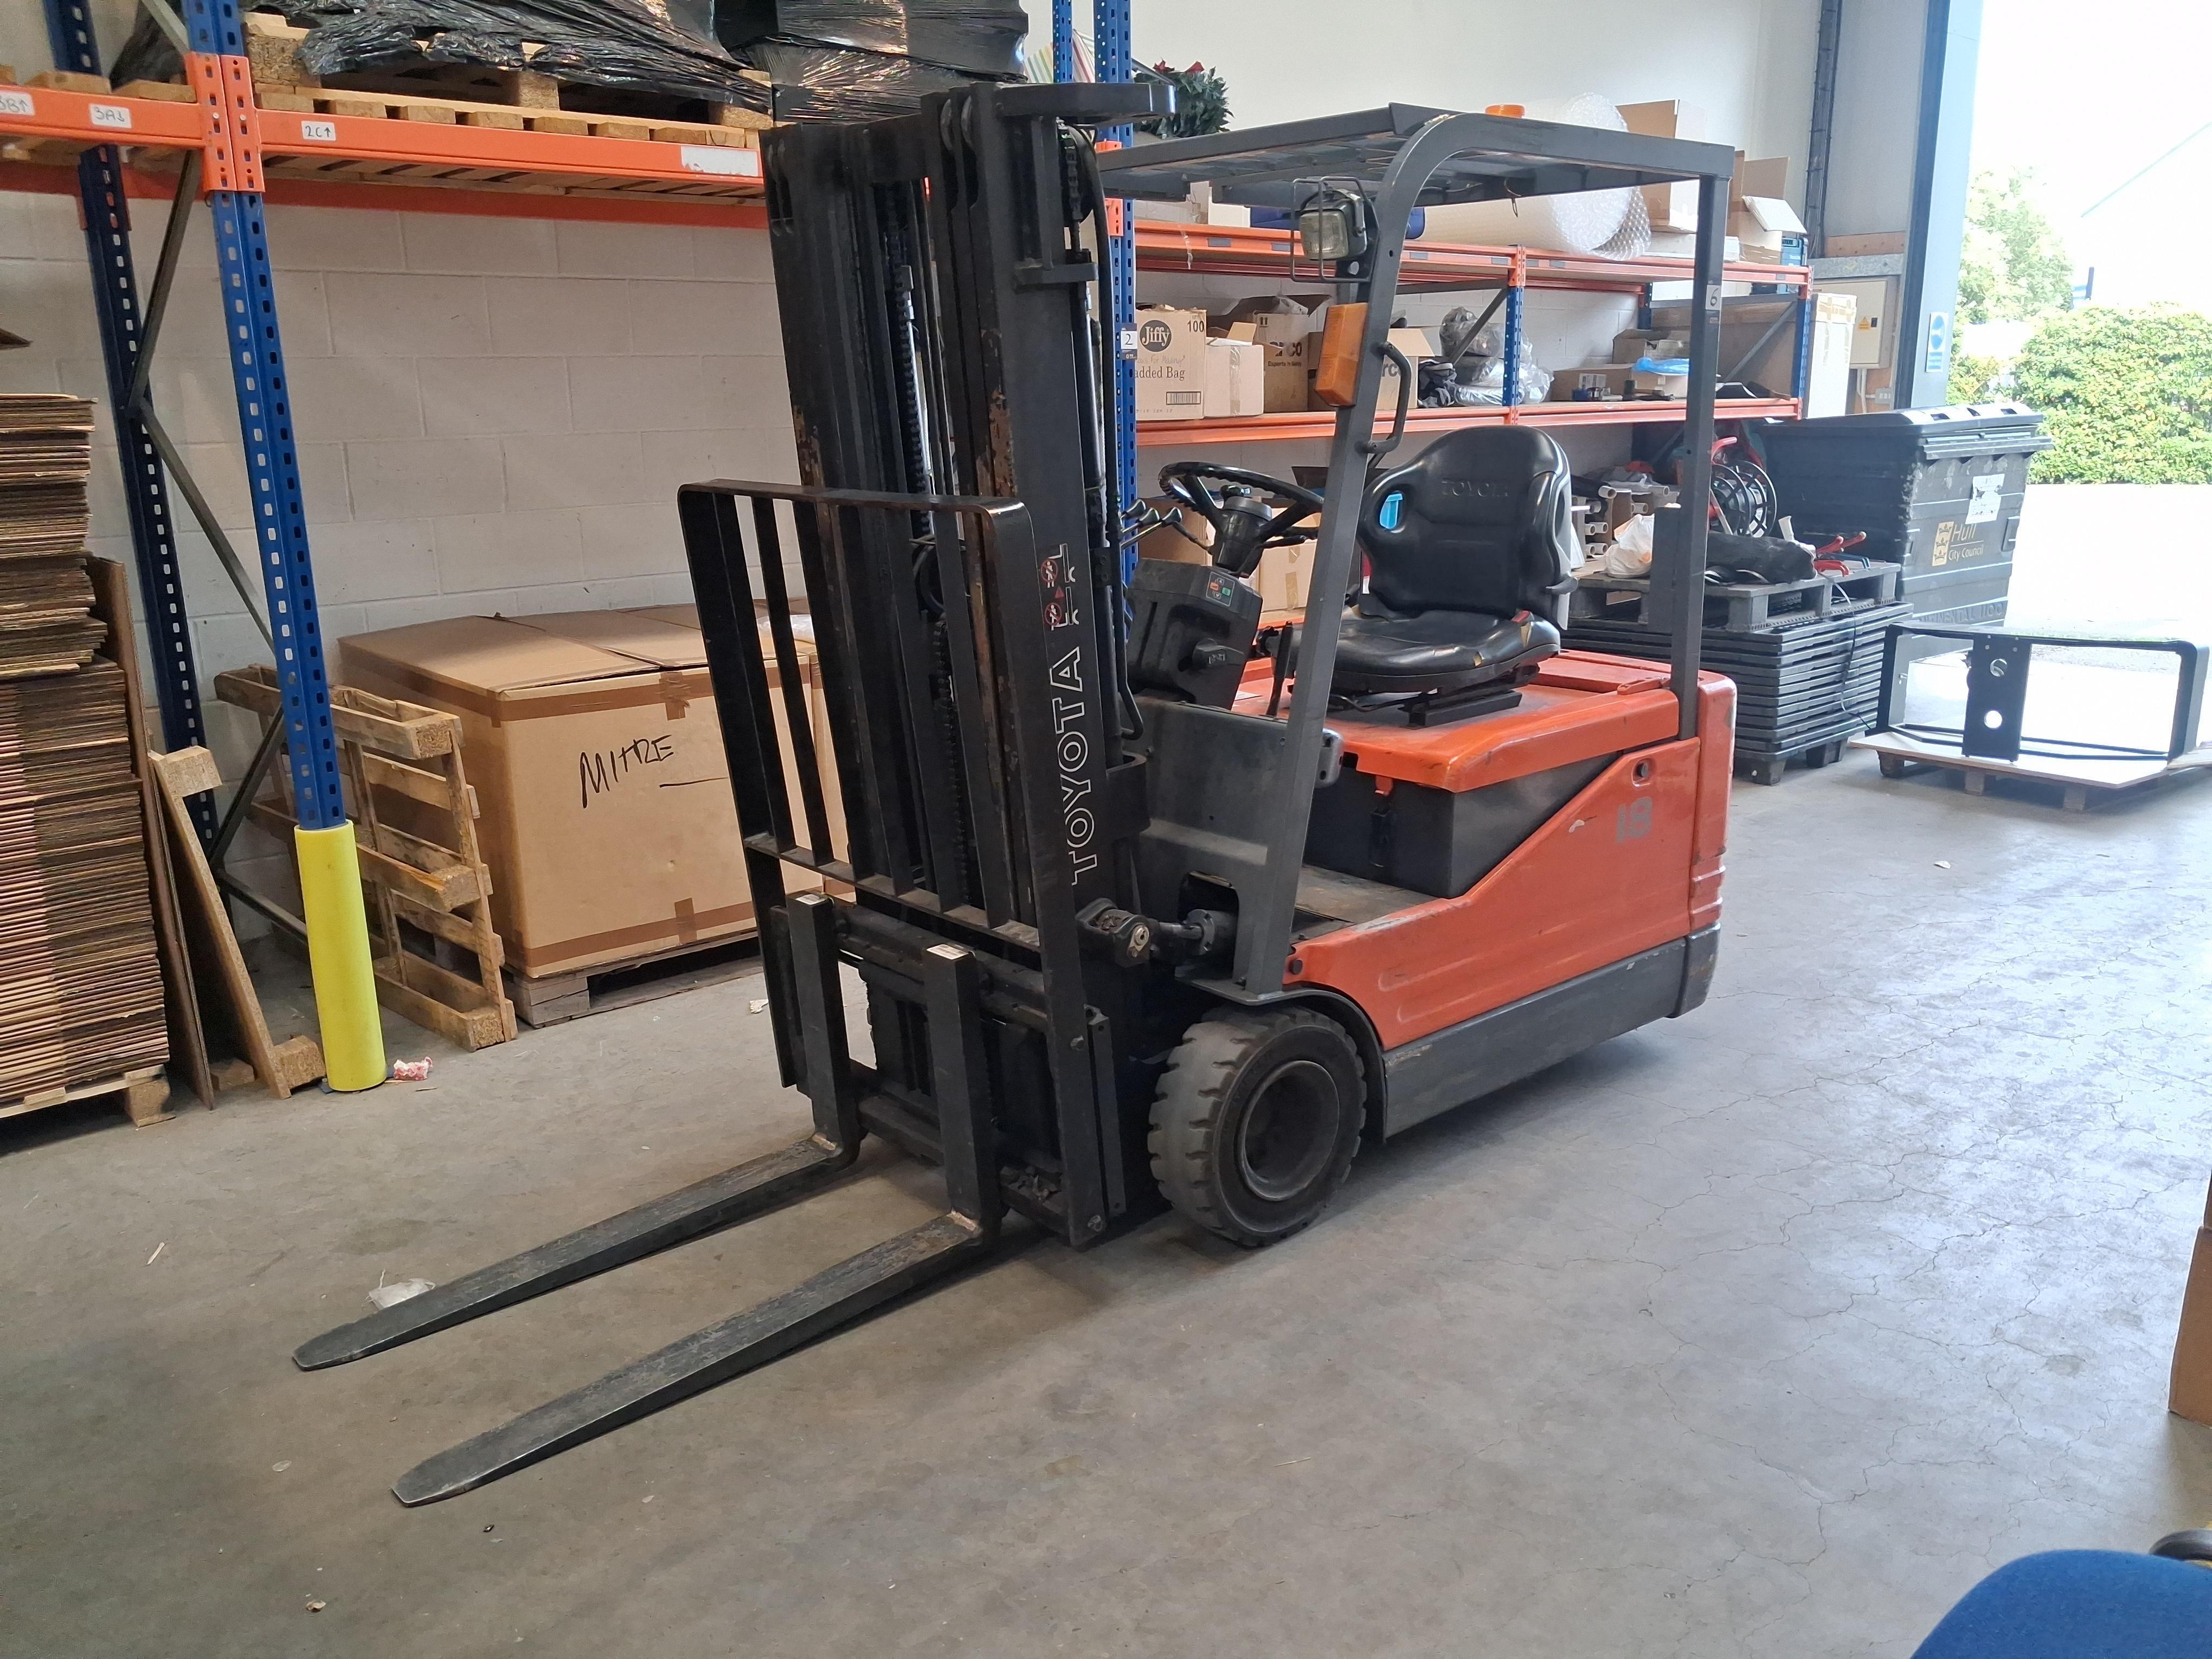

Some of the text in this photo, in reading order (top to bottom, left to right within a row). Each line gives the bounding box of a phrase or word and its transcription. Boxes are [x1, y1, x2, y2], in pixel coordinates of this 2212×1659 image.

[1710, 287, 1719, 307] 6
[1187, 320, 1205, 332] 100
[1124, 333, 1134, 345] 2
[1142, 326, 1170, 346] Jiffy
[1134, 365, 1186, 381] added Bag
[1951, 523, 1977, 542] Hull
[1949, 544, 1985, 562] City Council
[579, 734, 674, 809] MITRE
[1050, 646, 1098, 886] TOYOTA
[1615, 796, 1652, 844] 18
